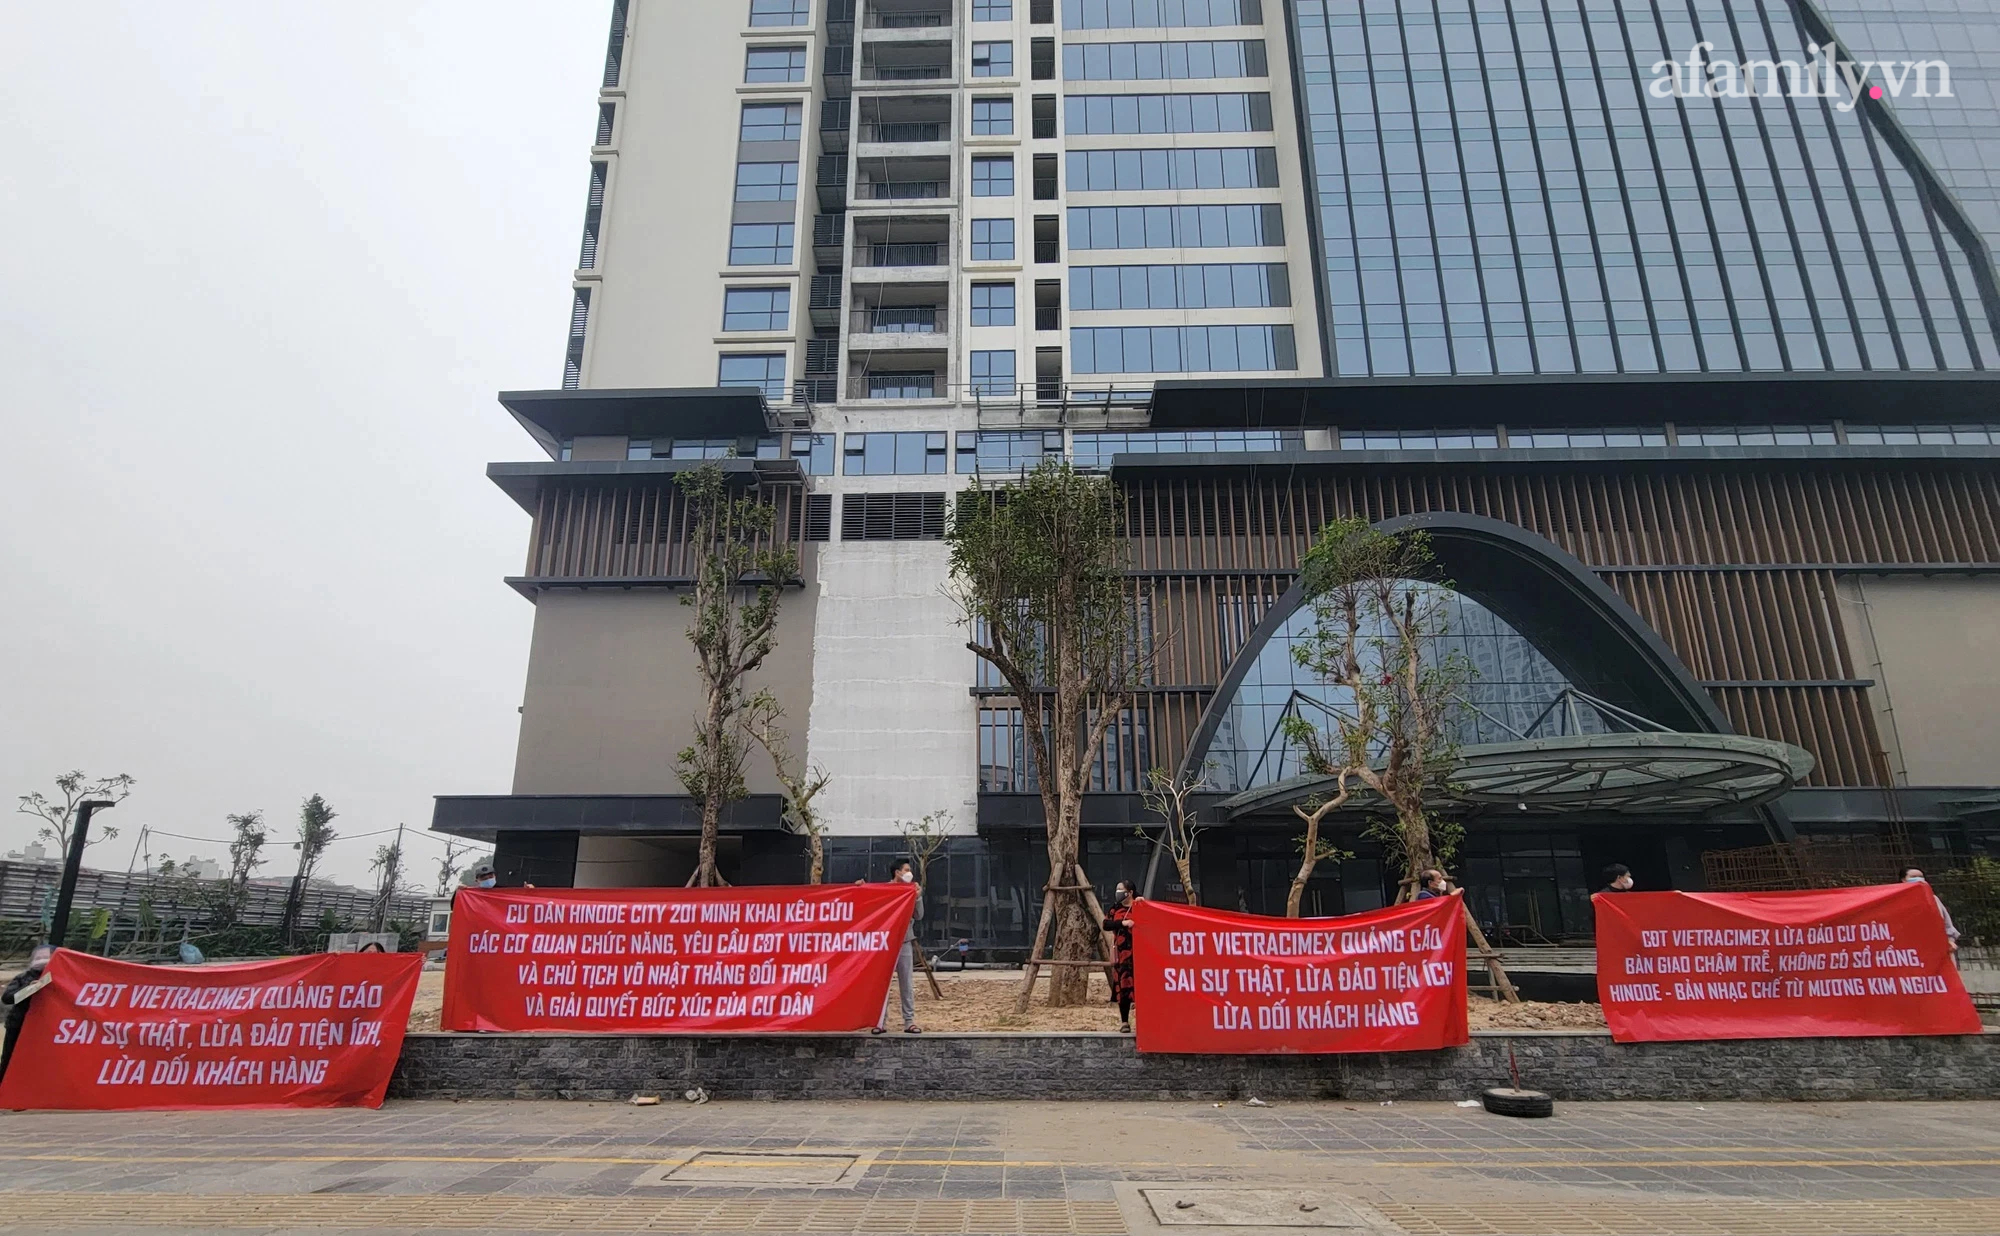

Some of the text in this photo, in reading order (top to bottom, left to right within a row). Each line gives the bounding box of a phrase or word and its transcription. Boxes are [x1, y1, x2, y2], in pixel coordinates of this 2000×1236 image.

[506, 897, 854, 924] CƯ DÂN HINODE CITY 201 MINH KHAI KÊU CỨU
[469, 928, 890, 956] CÁC CƠ QUAN CHỨC NĂNG, YÊU CẦU CĐT VIETRACIMEX
[1169, 924, 1443, 956] CĐT VIETRACIMEX QUẢNG CÁO
[1641, 920, 1895, 948] CĐT VIETRACIMEX LỪA ĐẢO CƯ DÂN,
[518, 958, 828, 989] VÀ CHỦ TỊCH VÕ NHẬT THĂNG ĐỐI THOẠI
[1625, 944, 1925, 975] BÀN GIAO CHẬM TRỄ, KHÔNG CÓ SỔ HỒNG,
[75, 980, 383, 1010] CĐT VIETRACIMEX QUẢNG CÁO
[1164, 967, 1196, 992] SAI
[1201, 968, 1230, 997] SỰ
[1235, 963, 1291, 997] THẬT,
[1295, 965, 1334, 993] LỪA
[1338, 962, 1376, 991] ĐẢO
[1381, 962, 1419, 993] TIỆN
[1609, 983, 1662, 1002] HINODE
[1674, 979, 1705, 1001] BẢN
[1708, 982, 1748, 1003] NHẠC
[1751, 977, 1782, 999] CHẾ
[1785, 977, 1804, 998] TỪ
[1808, 978, 1865, 997] MƯƠNG
[1868, 977, 1897, 995] KIM
[1901, 975, 1948, 994] NGƯU
[525, 990, 815, 1018] VÀ GIẢI QUYẾT BỨC XÚC CỦA CƯ DÂN
[1212, 998, 1419, 1030] LỪA DỐI KHÁCH HÀNG
[54, 1017, 382, 1052] SAI SỰ THẬT, LỪA ĐẢO TIỆN ÍCH,
[96, 1054, 329, 1085] LỪA DỐI KHÁCH HÀNG
